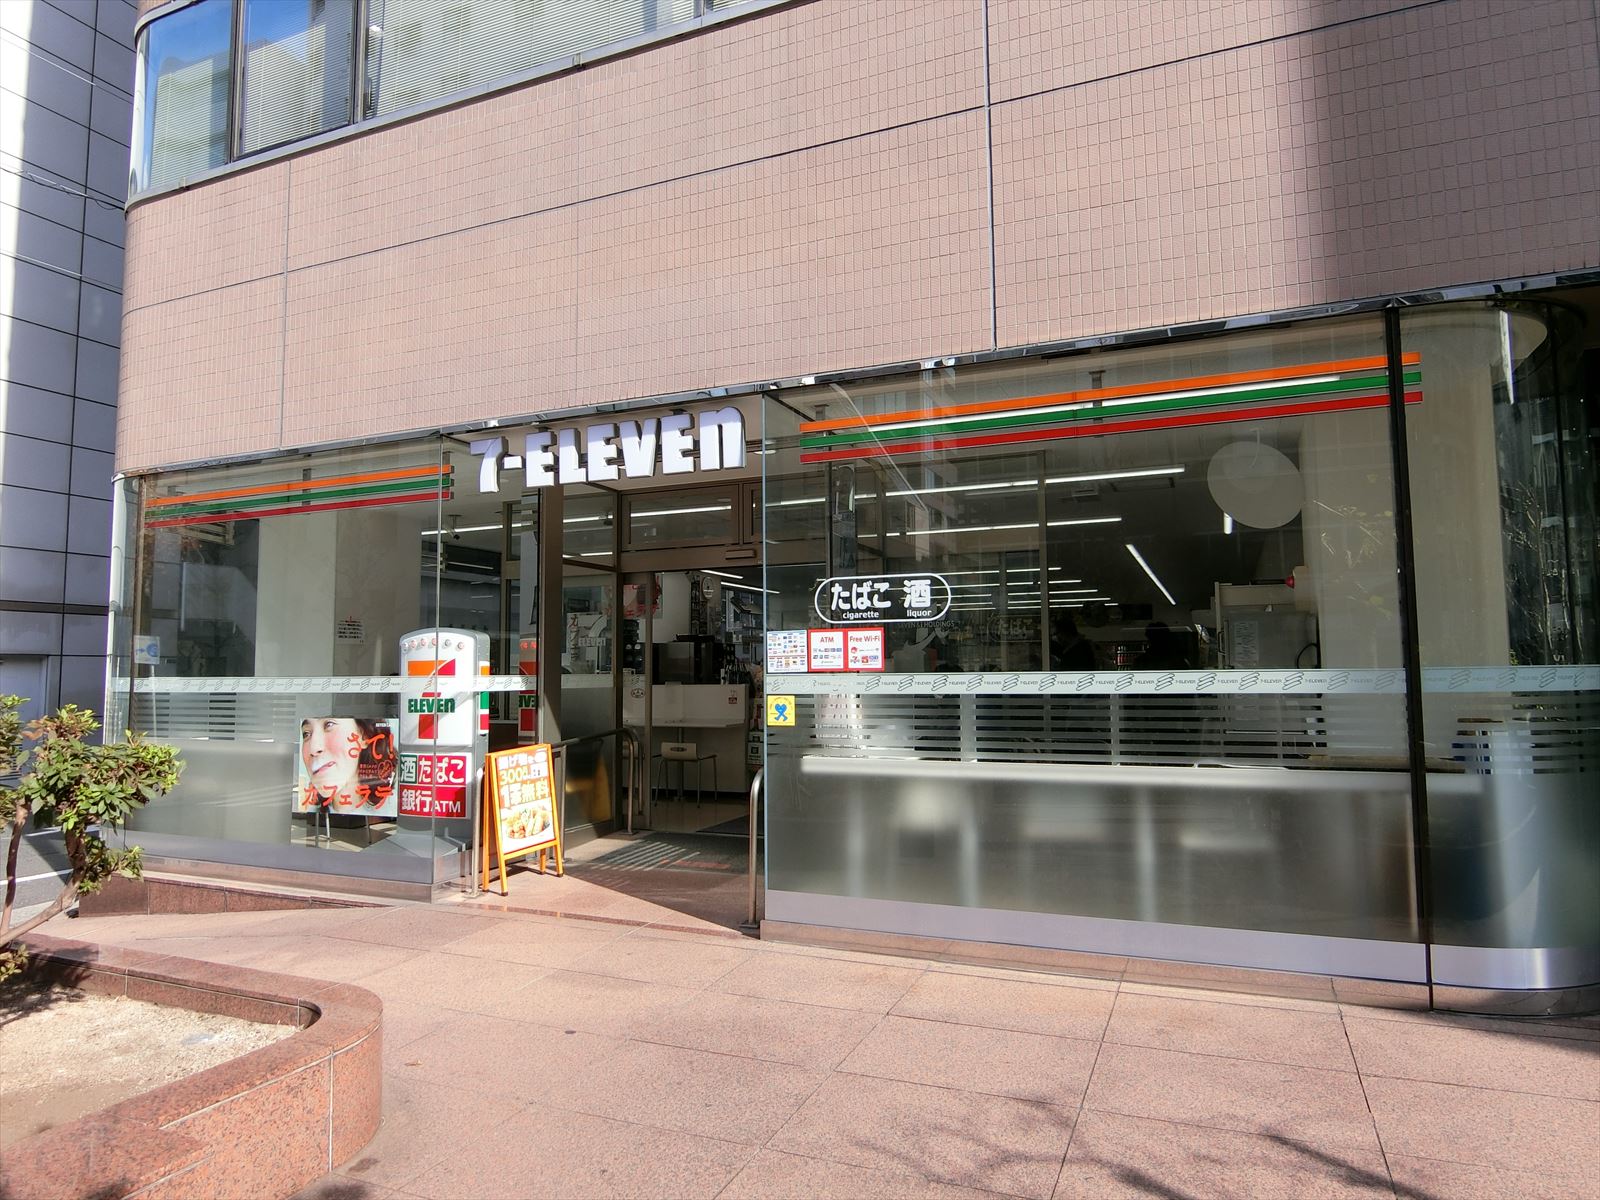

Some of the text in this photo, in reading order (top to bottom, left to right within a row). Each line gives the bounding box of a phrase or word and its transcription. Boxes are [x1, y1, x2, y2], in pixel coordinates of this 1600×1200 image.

[831, 580, 931, 610] たばこ 酒
[842, 609, 932, 619] cigarette liquor
[400, 757, 417, 783] 酒
[419, 757, 465, 784] たばこ
[301, 783, 394, 810] カフェラテ
[402, 788, 461, 813] 銀行 ATM
